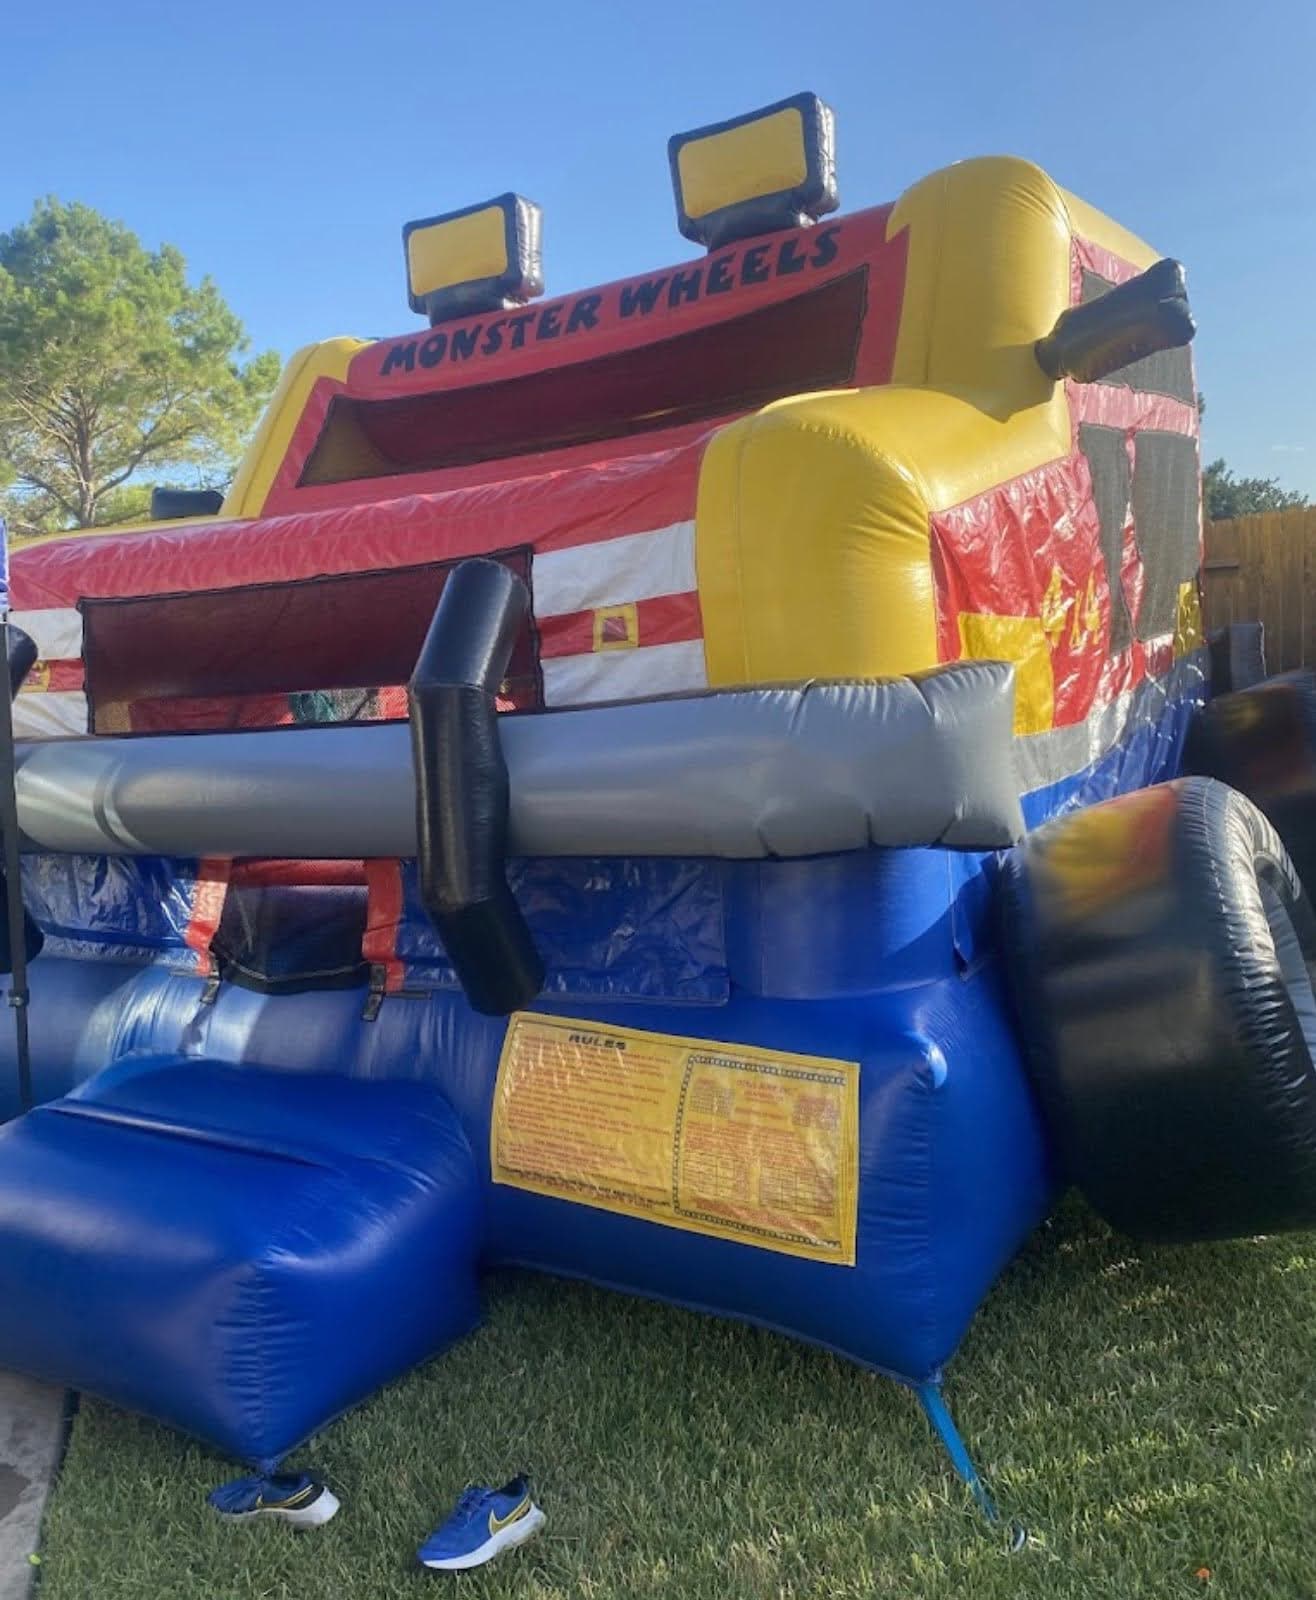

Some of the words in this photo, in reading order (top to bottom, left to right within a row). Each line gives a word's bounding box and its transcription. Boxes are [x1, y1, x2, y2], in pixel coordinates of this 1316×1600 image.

[381, 297, 601, 376] MONSTER
[619, 227, 841, 318] WHEELS
[568, 1034, 626, 1050] RULES
